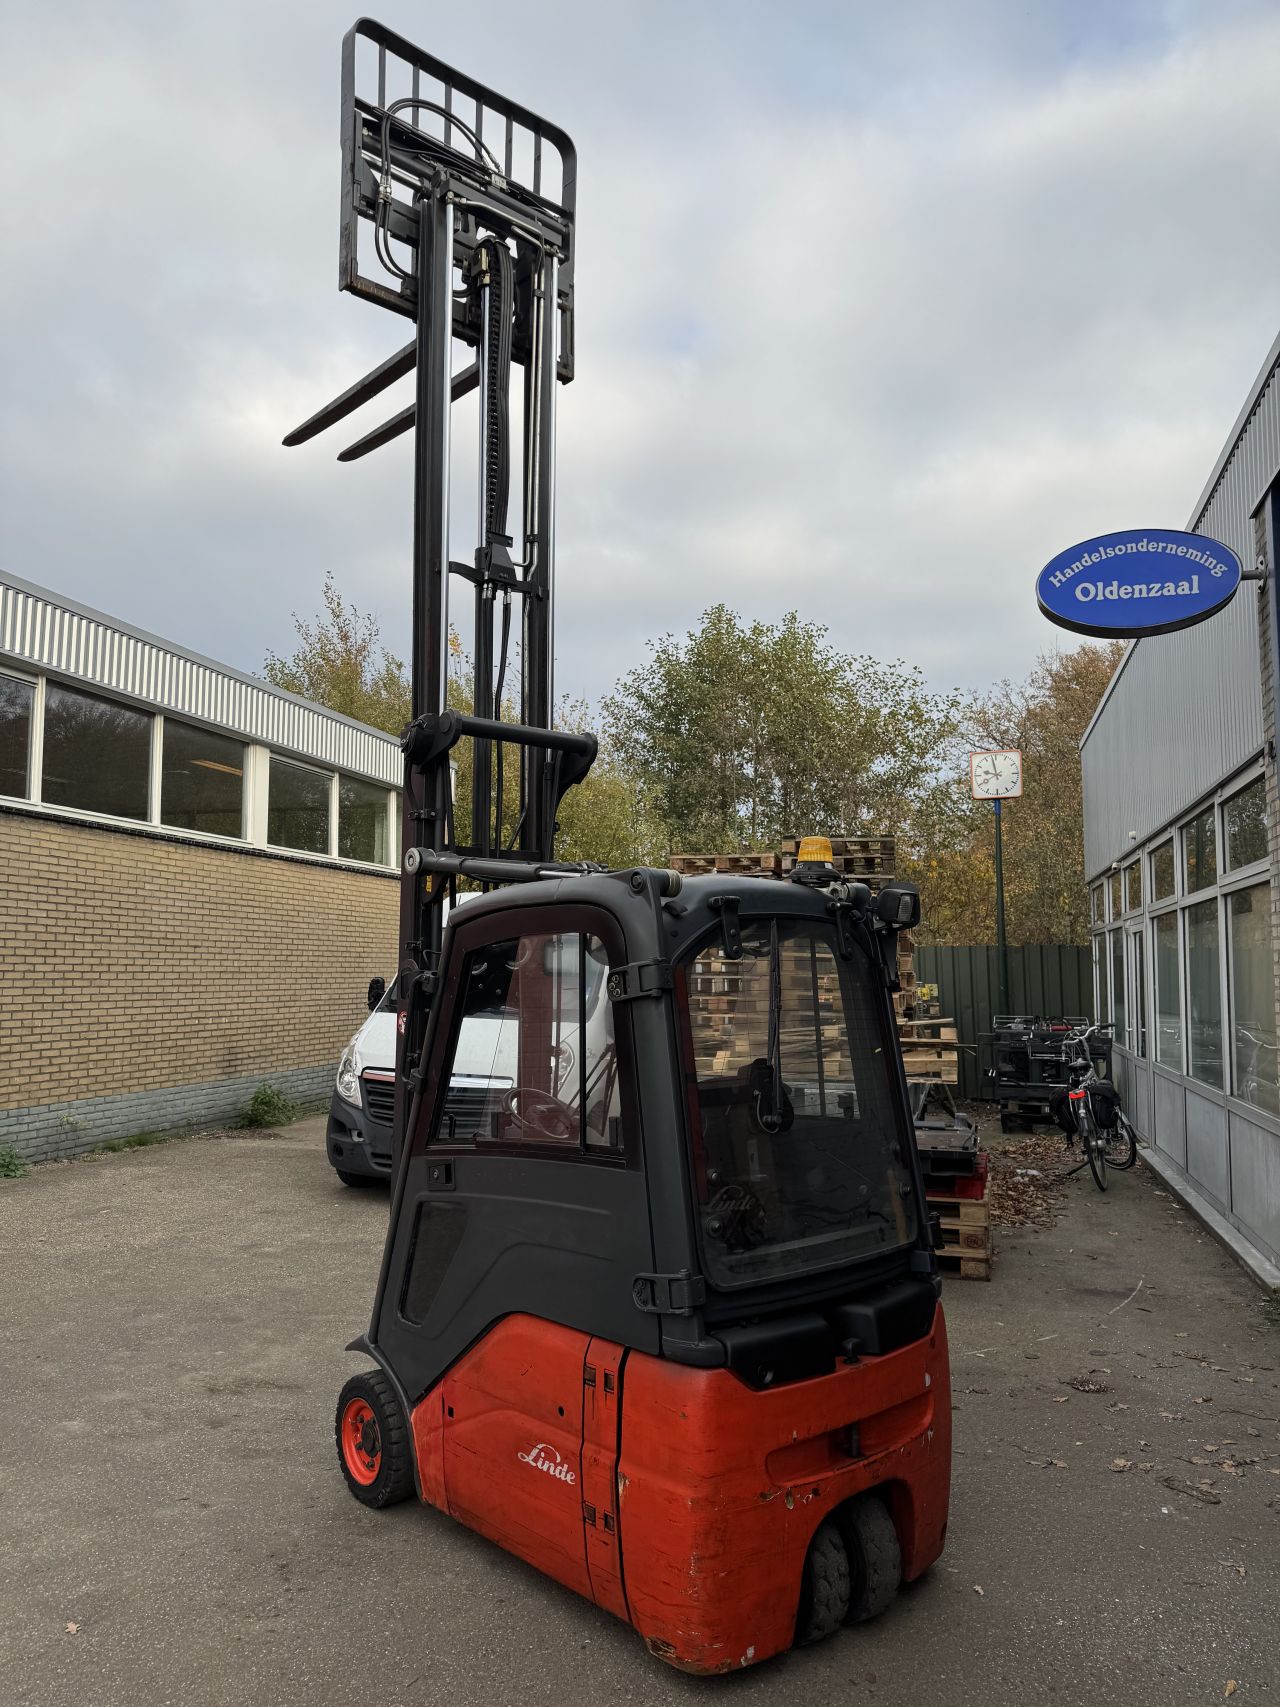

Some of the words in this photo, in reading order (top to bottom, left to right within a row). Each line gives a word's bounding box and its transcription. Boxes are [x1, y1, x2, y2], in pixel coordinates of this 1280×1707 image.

[1048, 537, 1229, 588] Handelsonderneming
[1074, 575, 1200, 602] Oldenzaal
[706, 1185, 755, 1211] Linde
[517, 1443, 576, 1485] Linde
